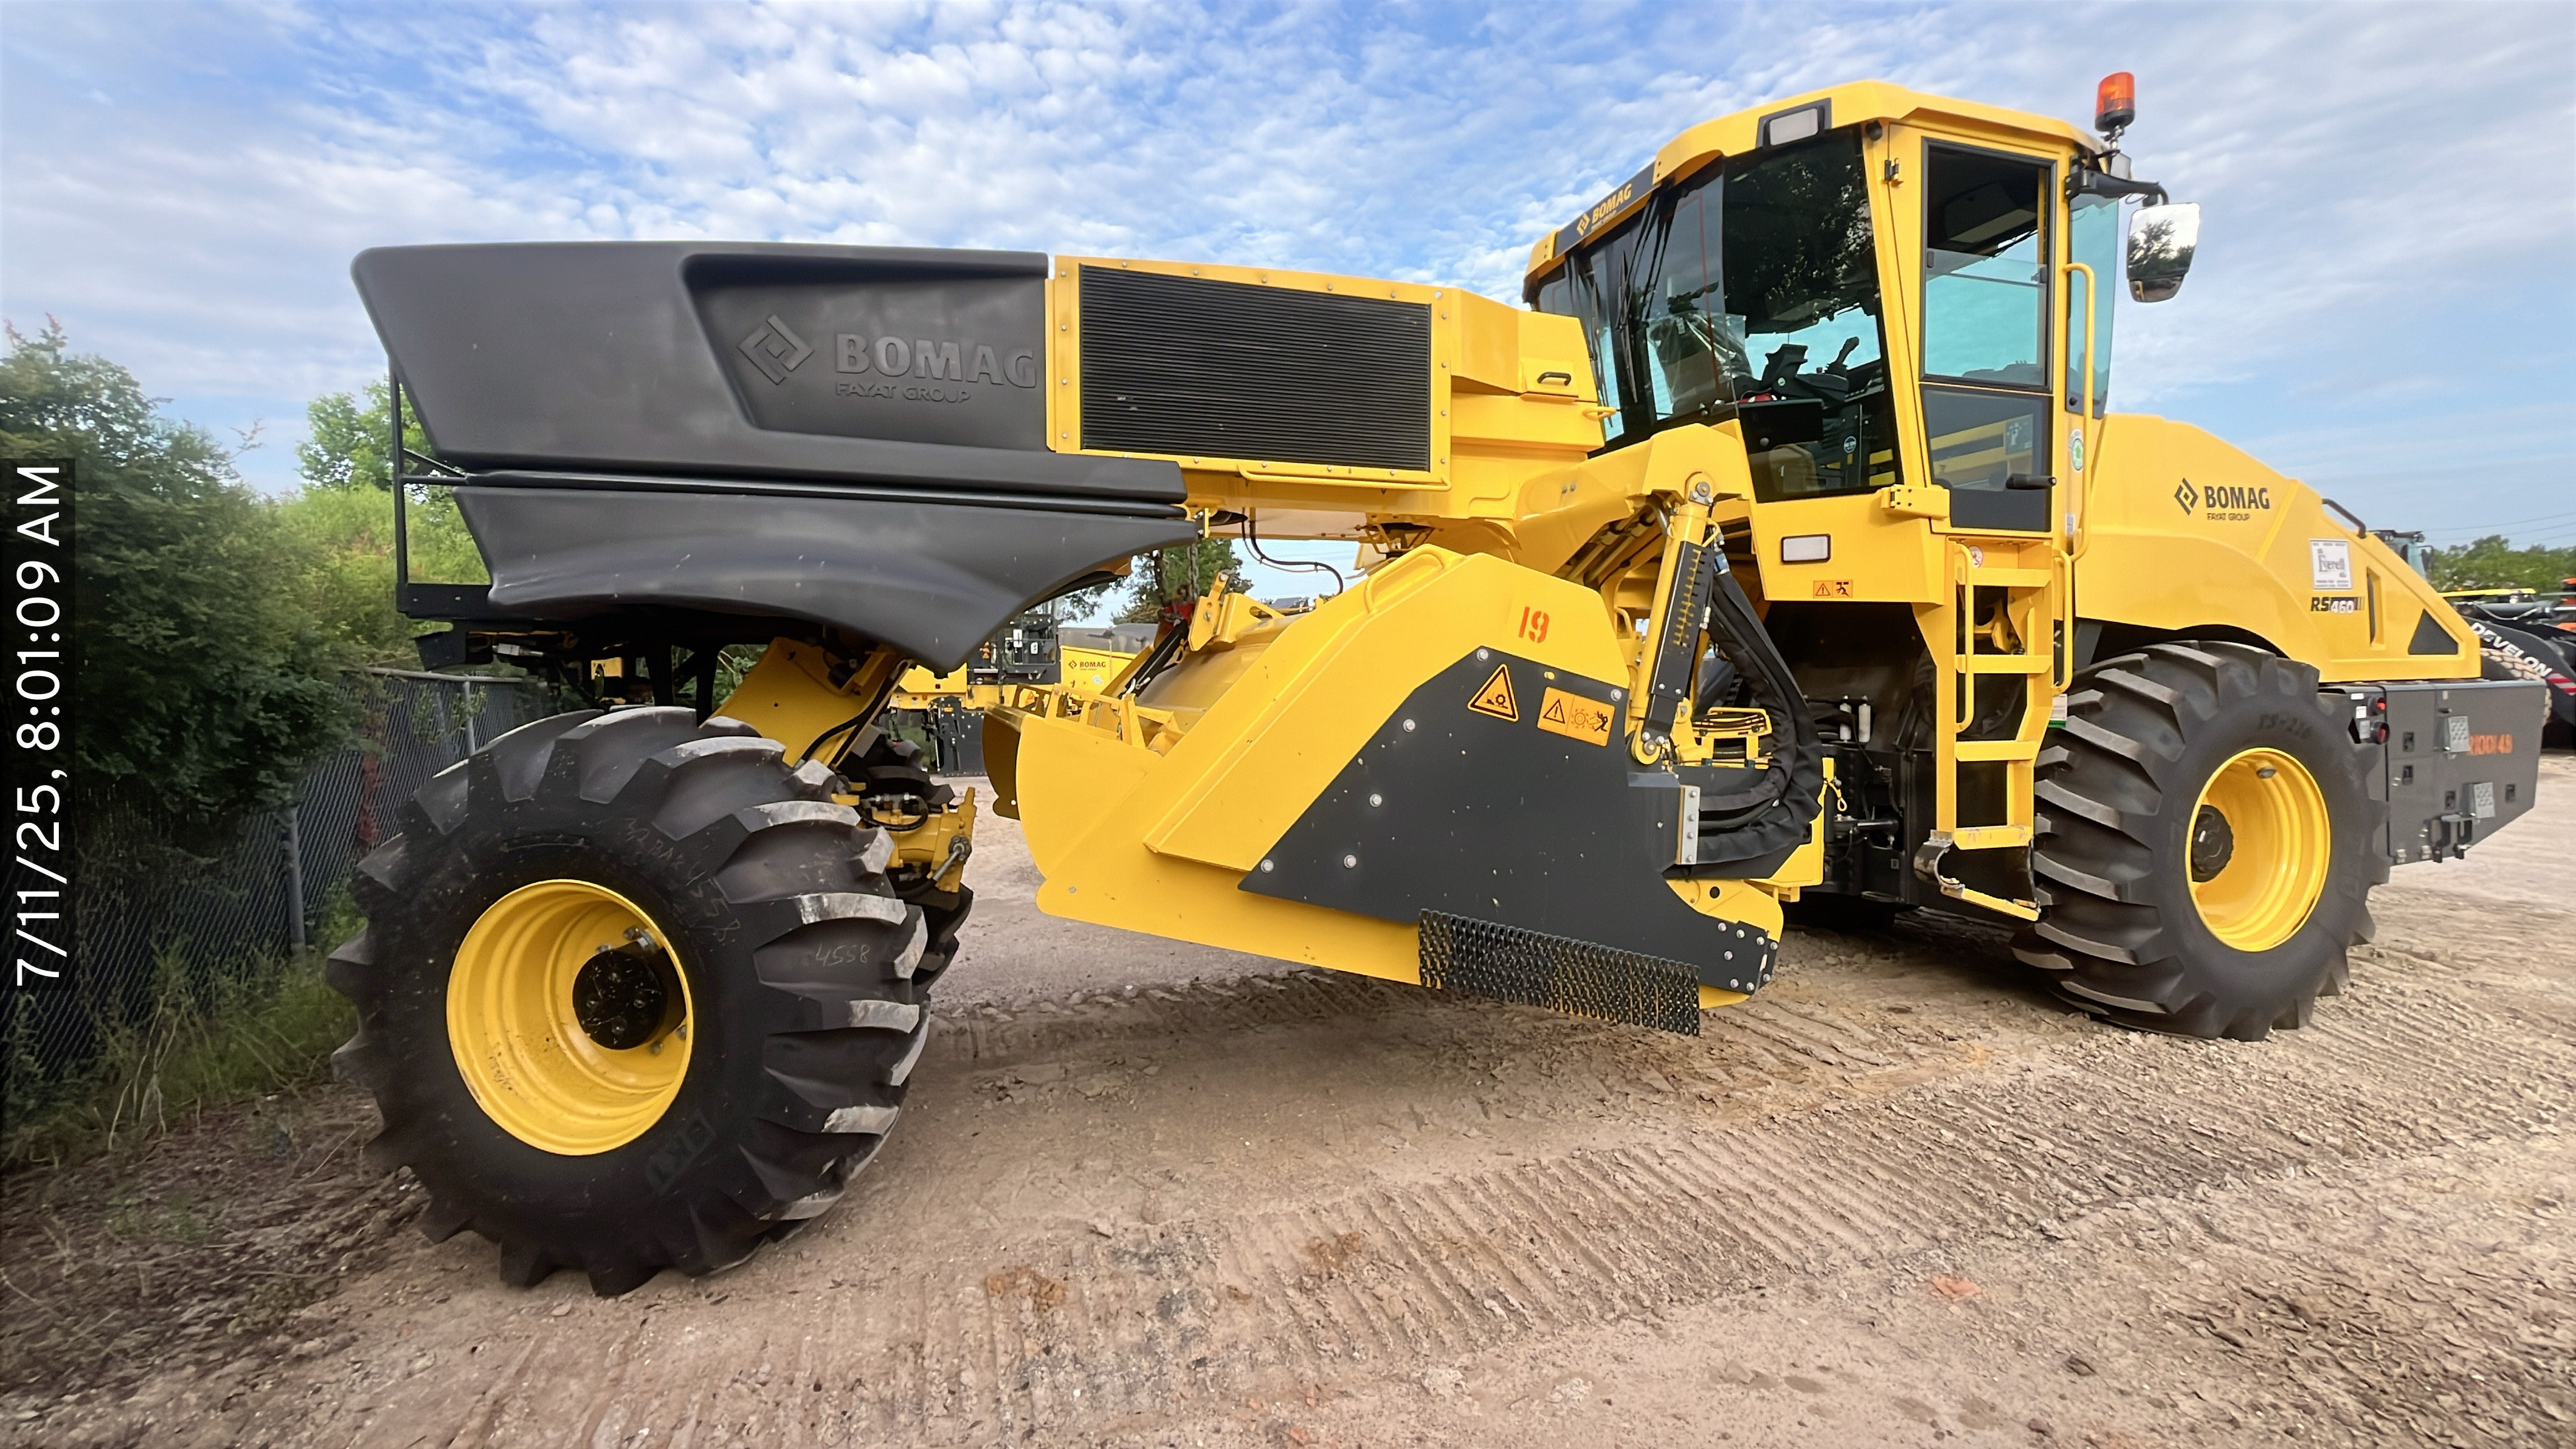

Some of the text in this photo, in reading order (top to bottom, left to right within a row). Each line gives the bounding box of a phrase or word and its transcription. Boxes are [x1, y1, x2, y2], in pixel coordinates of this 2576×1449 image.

[1592, 183, 1632, 224] BOMAG
[835, 333, 1037, 388] BOMAG
[836, 383, 971, 404] FAYAT GROUP
[2204, 485, 2271, 510] BOMAG
[2228, 513, 2250, 521] GROUP
[1518, 606, 1550, 644] 19
[2471, 622, 2553, 677] DEVELON
[816, 941, 871, 967] 4558
